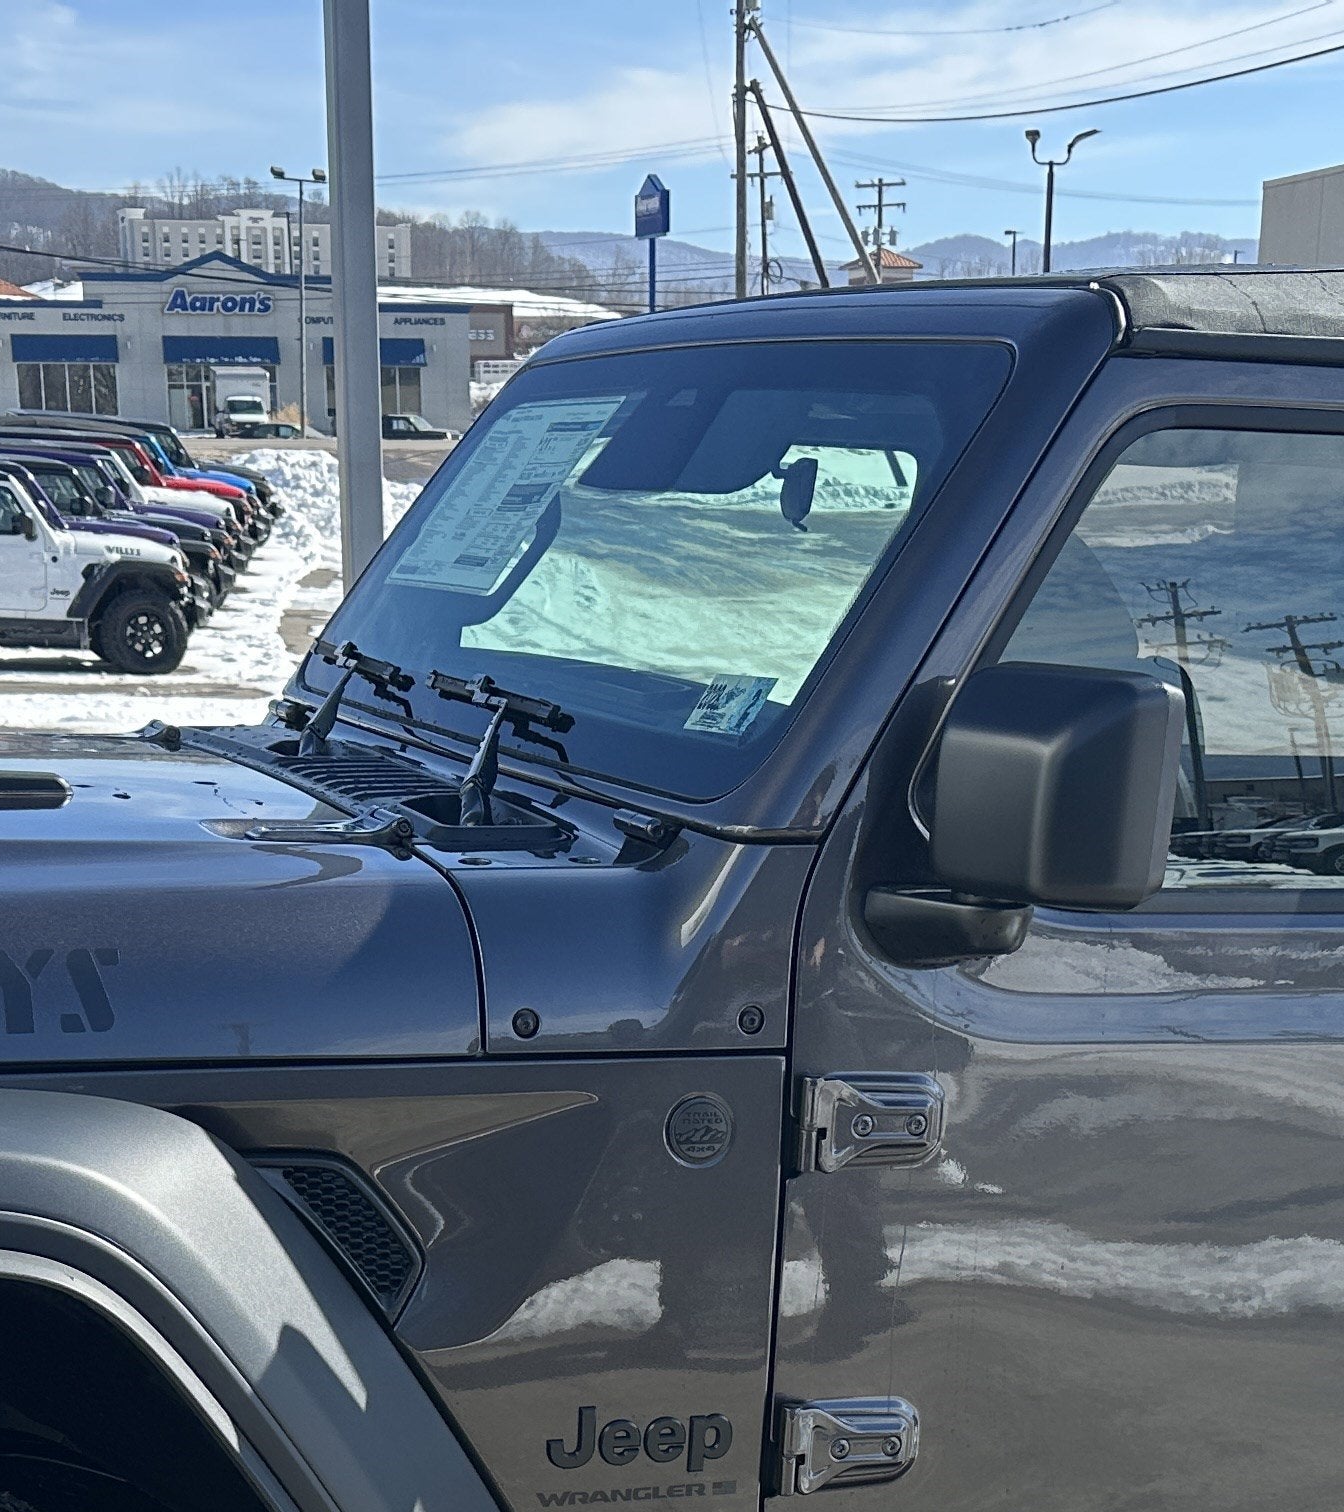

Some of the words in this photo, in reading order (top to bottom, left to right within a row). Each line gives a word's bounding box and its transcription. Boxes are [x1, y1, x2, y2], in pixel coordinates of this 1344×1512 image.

[165, 287, 273, 313] Aaron's
[62, 313, 125, 322] ELECTRONICS
[393, 317, 445, 325] APPLIANCES
[545, 1405, 733, 1473] Jeep
[535, 1483, 706, 1508] WRANGLER
